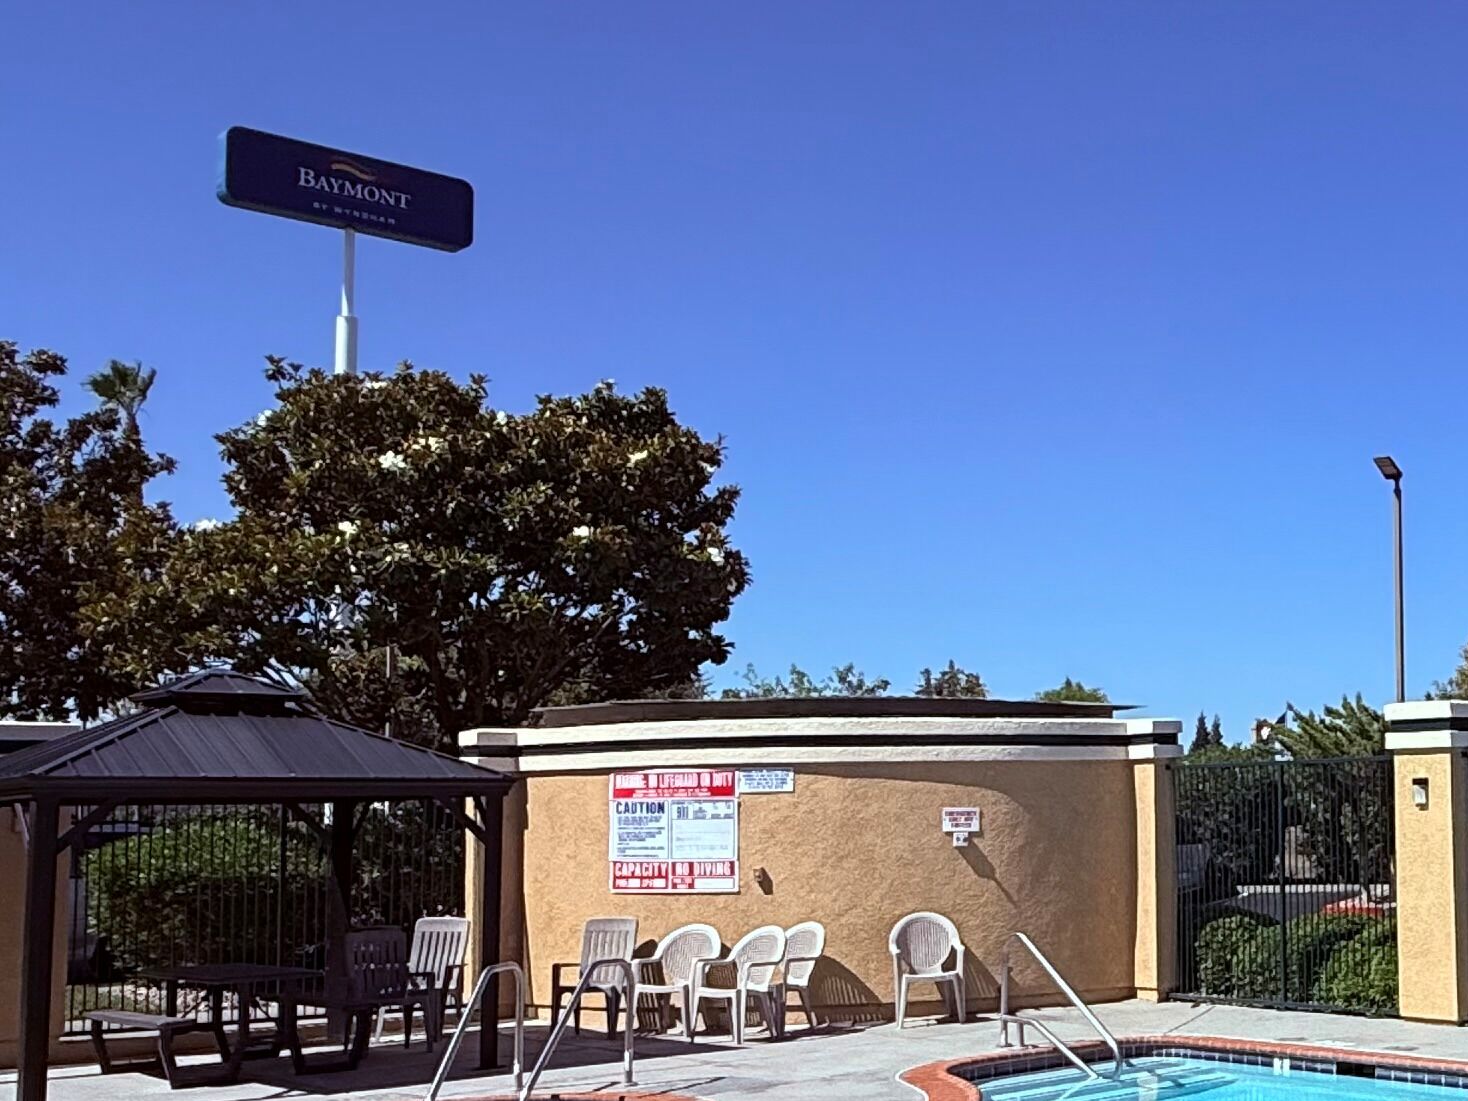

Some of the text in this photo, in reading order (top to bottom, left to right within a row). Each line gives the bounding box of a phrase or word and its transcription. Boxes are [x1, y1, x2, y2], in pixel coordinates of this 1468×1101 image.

[298, 166, 411, 209] BAYMONT
[616, 801, 665, 814] CAUTION
[615, 862, 668, 877] CAPACITY
[675, 862, 731, 876] NO DIVING
